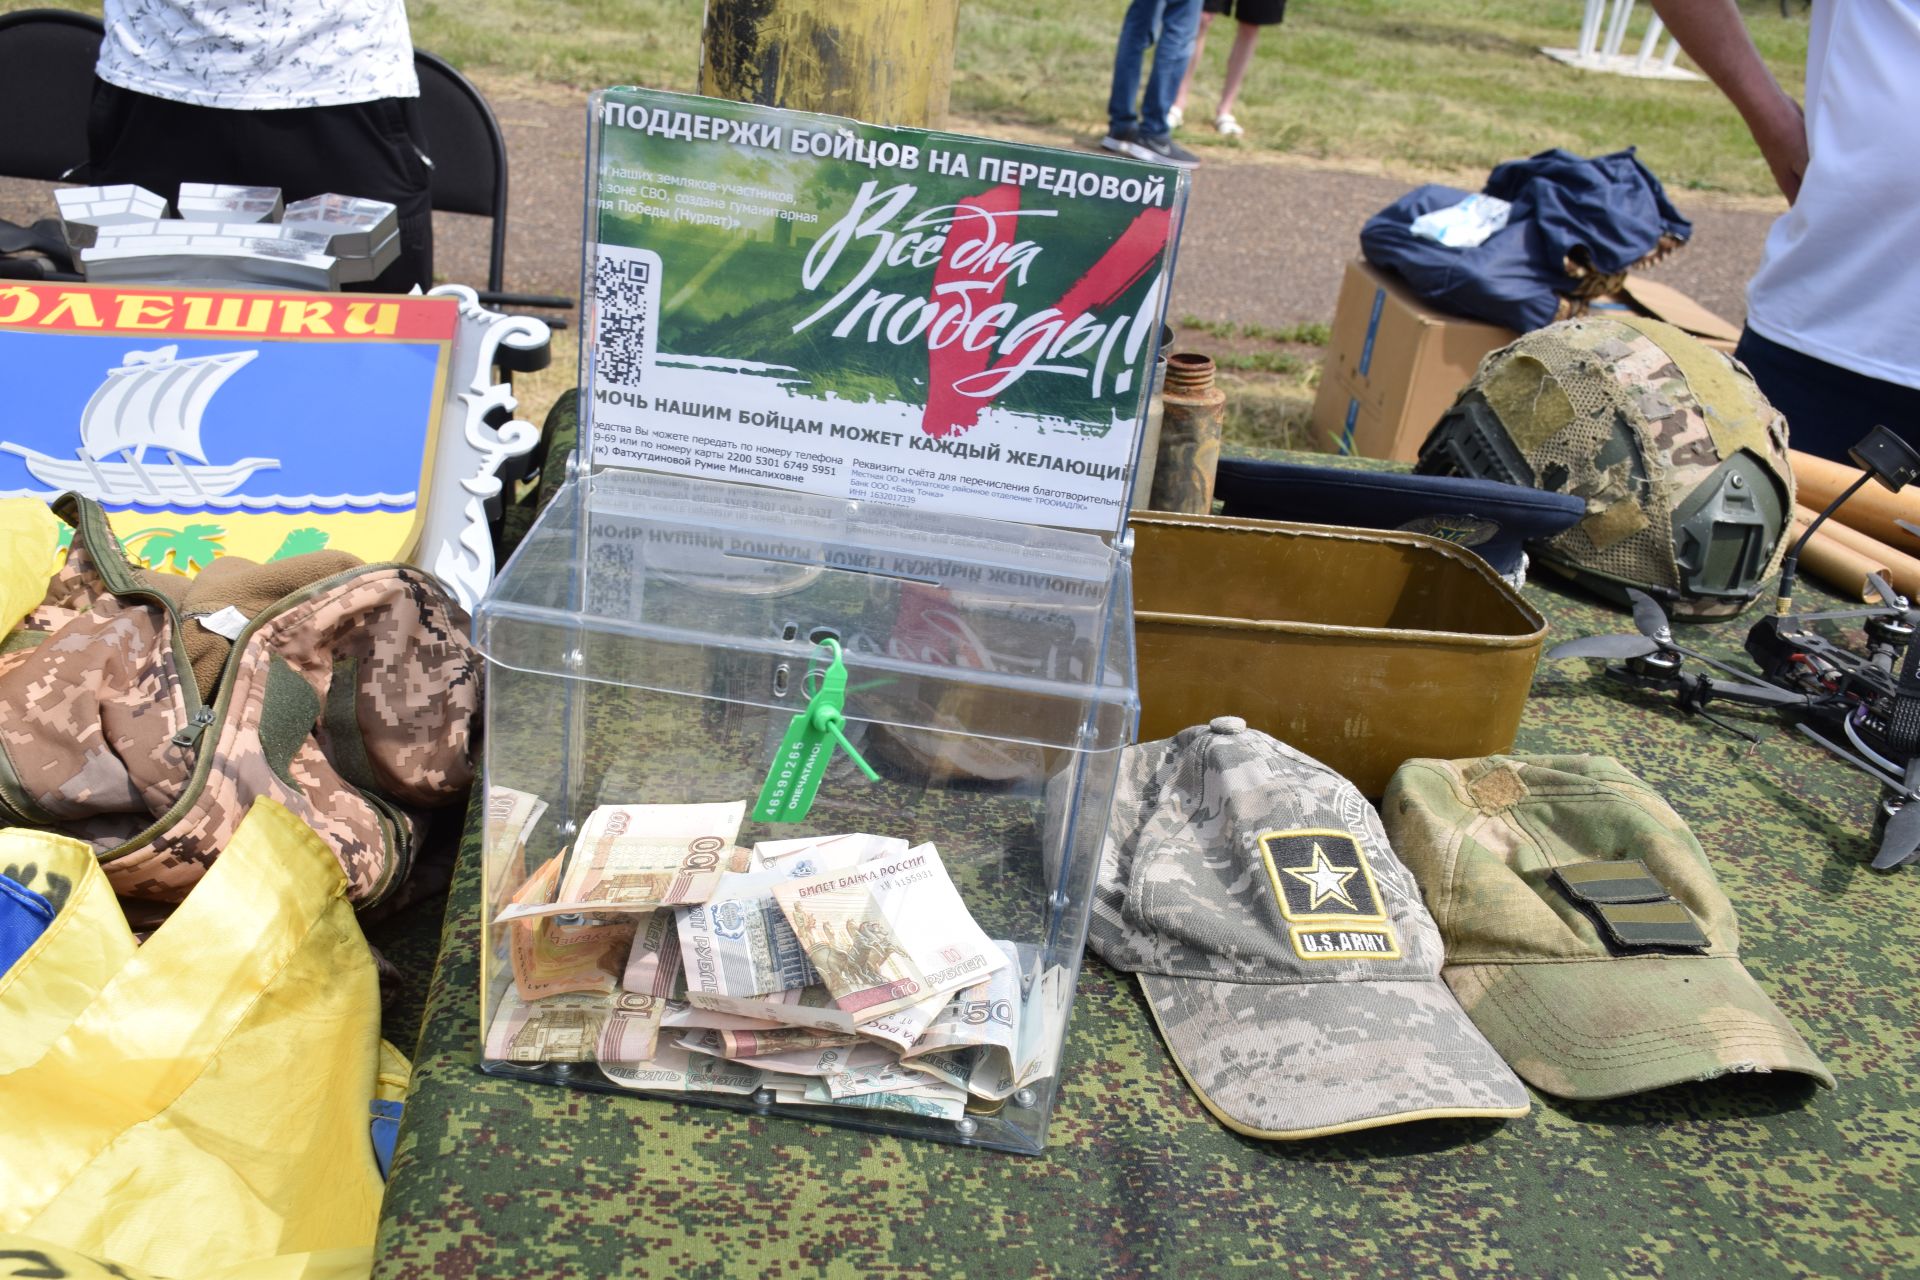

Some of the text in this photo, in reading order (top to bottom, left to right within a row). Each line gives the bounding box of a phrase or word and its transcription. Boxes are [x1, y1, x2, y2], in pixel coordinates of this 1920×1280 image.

[604, 101, 1165, 206] ПОДДЕРЖИ БОЙЦОВ НА ПЕРЕДОВОЙ
[607, 183, 636, 196] зоне
[640, 186, 670, 202] СВО,
[675, 193, 725, 210] создана
[729, 201, 818, 223] гуманитарная
[612, 169, 653, 182] наших
[656, 173, 797, 205] земляков-участников,
[618, 199, 670, 218] Победы
[792, 180, 1058, 334] Всё для
[831, 268, 1163, 399] победы!
[635, 425, 649, 436] Вы
[652, 431, 690, 442] можете
[692, 437, 738, 450] передать
[740, 443, 753, 452] по
[756, 445, 793, 458] номеру
[795, 450, 844, 466] телефона
[654, 398, 732, 422] НАШИМ
[738, 410, 824, 436] БОЙЦАМ
[829, 423, 904, 448] МОЖЕТ
[908, 435, 1001, 463] КАЖДЫЙ
[612, 446, 691, 466] Фатхутдиновой
[694, 458, 726, 472] Румие
[729, 464, 805, 483] Минсалиховне
[619, 438, 638, 447] или
[641, 441, 653, 449] по
[656, 443, 692, 456] номеру
[694, 448, 724, 460] карты
[727, 451, 752, 463] 2200
[755, 456, 780, 468] 5301
[783, 460, 808, 472] 6749
[811, 465, 836, 476] 5951
[851, 458, 906, 475] Реквизиты
[907, 465, 937, 481] счёта
[938, 472, 957, 482] для
[959, 475, 1030, 493] перечисления
[849, 488, 867, 497] ИНН
[850, 479, 869, 488] Банк
[871, 481, 890, 491] ООО
[886, 475, 899, 483] ОО
[952, 485, 990, 497] районное
[991, 491, 1033, 503] отделение
[765, 742, 804, 816] 46590265
[788, 743, 822, 811] ОПЕЧАТАНО!
[604, 811, 633, 837] 100
[678, 835, 725, 877] 100
[798, 855, 925, 898] БИЛЕТ БАНКА РОССИИ
[693, 936, 719, 995] РУБЛЕ
[924, 953, 988, 987] РУБЛЕЙ
[612, 991, 656, 1019] 10
[890, 980, 920, 999] СТО
[961, 998, 1013, 1029] 50
